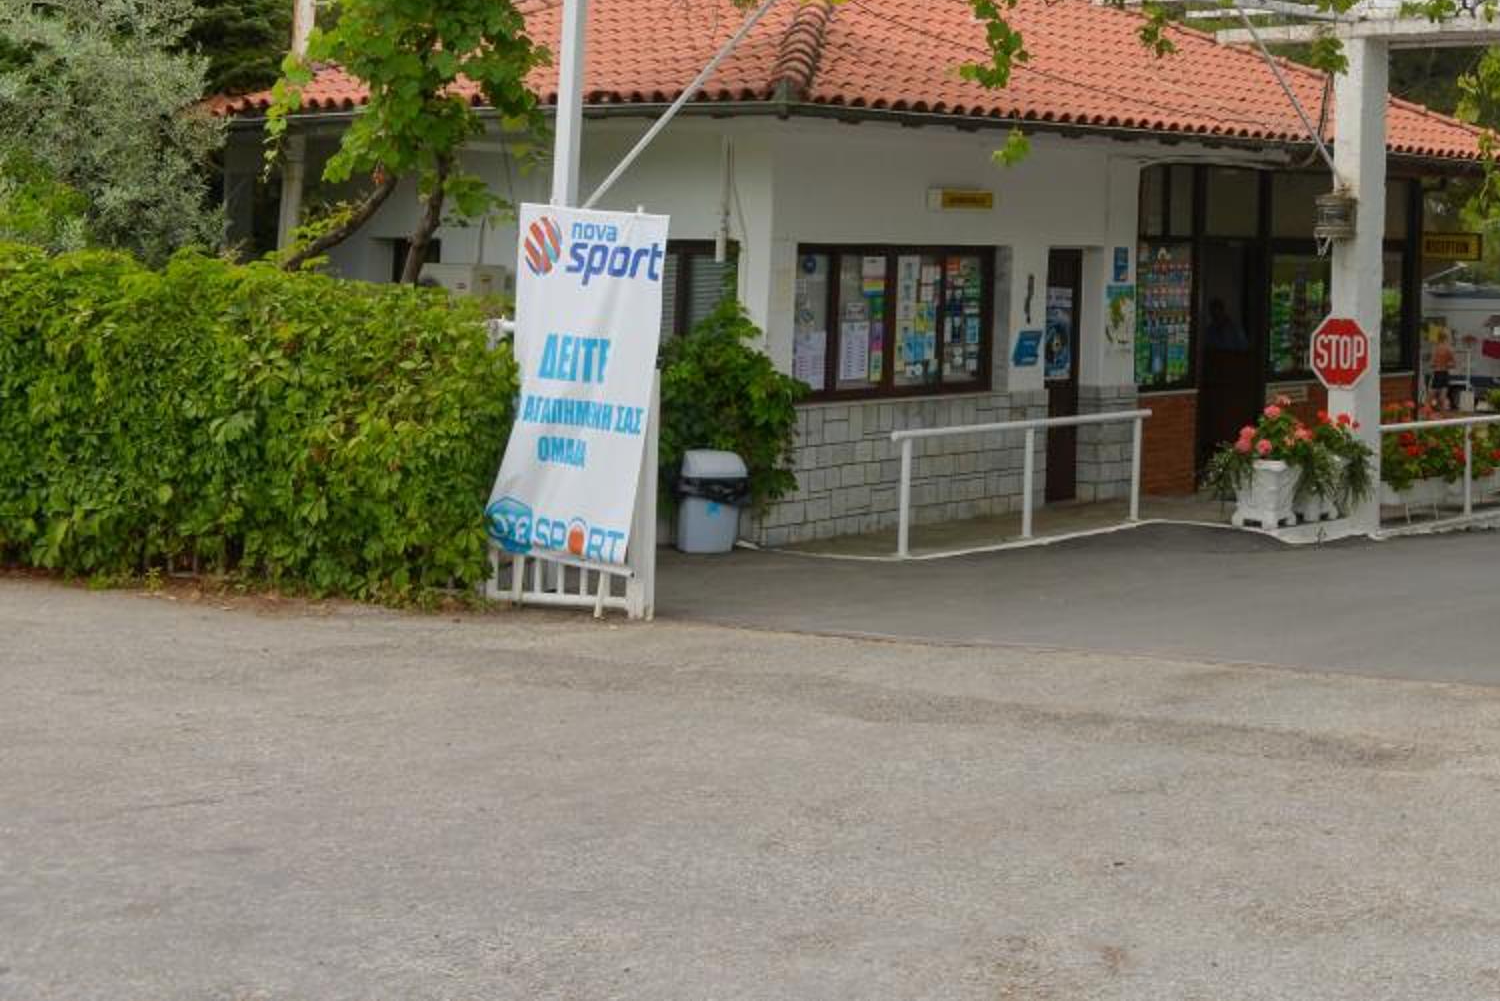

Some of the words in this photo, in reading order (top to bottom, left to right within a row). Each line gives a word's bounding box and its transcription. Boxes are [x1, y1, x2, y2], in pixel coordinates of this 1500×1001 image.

[572, 221, 618, 242] nova
[565, 240, 664, 287] sport
[1314, 333, 1367, 371] STOP
[614, 404, 645, 435] ΣΑΣ
